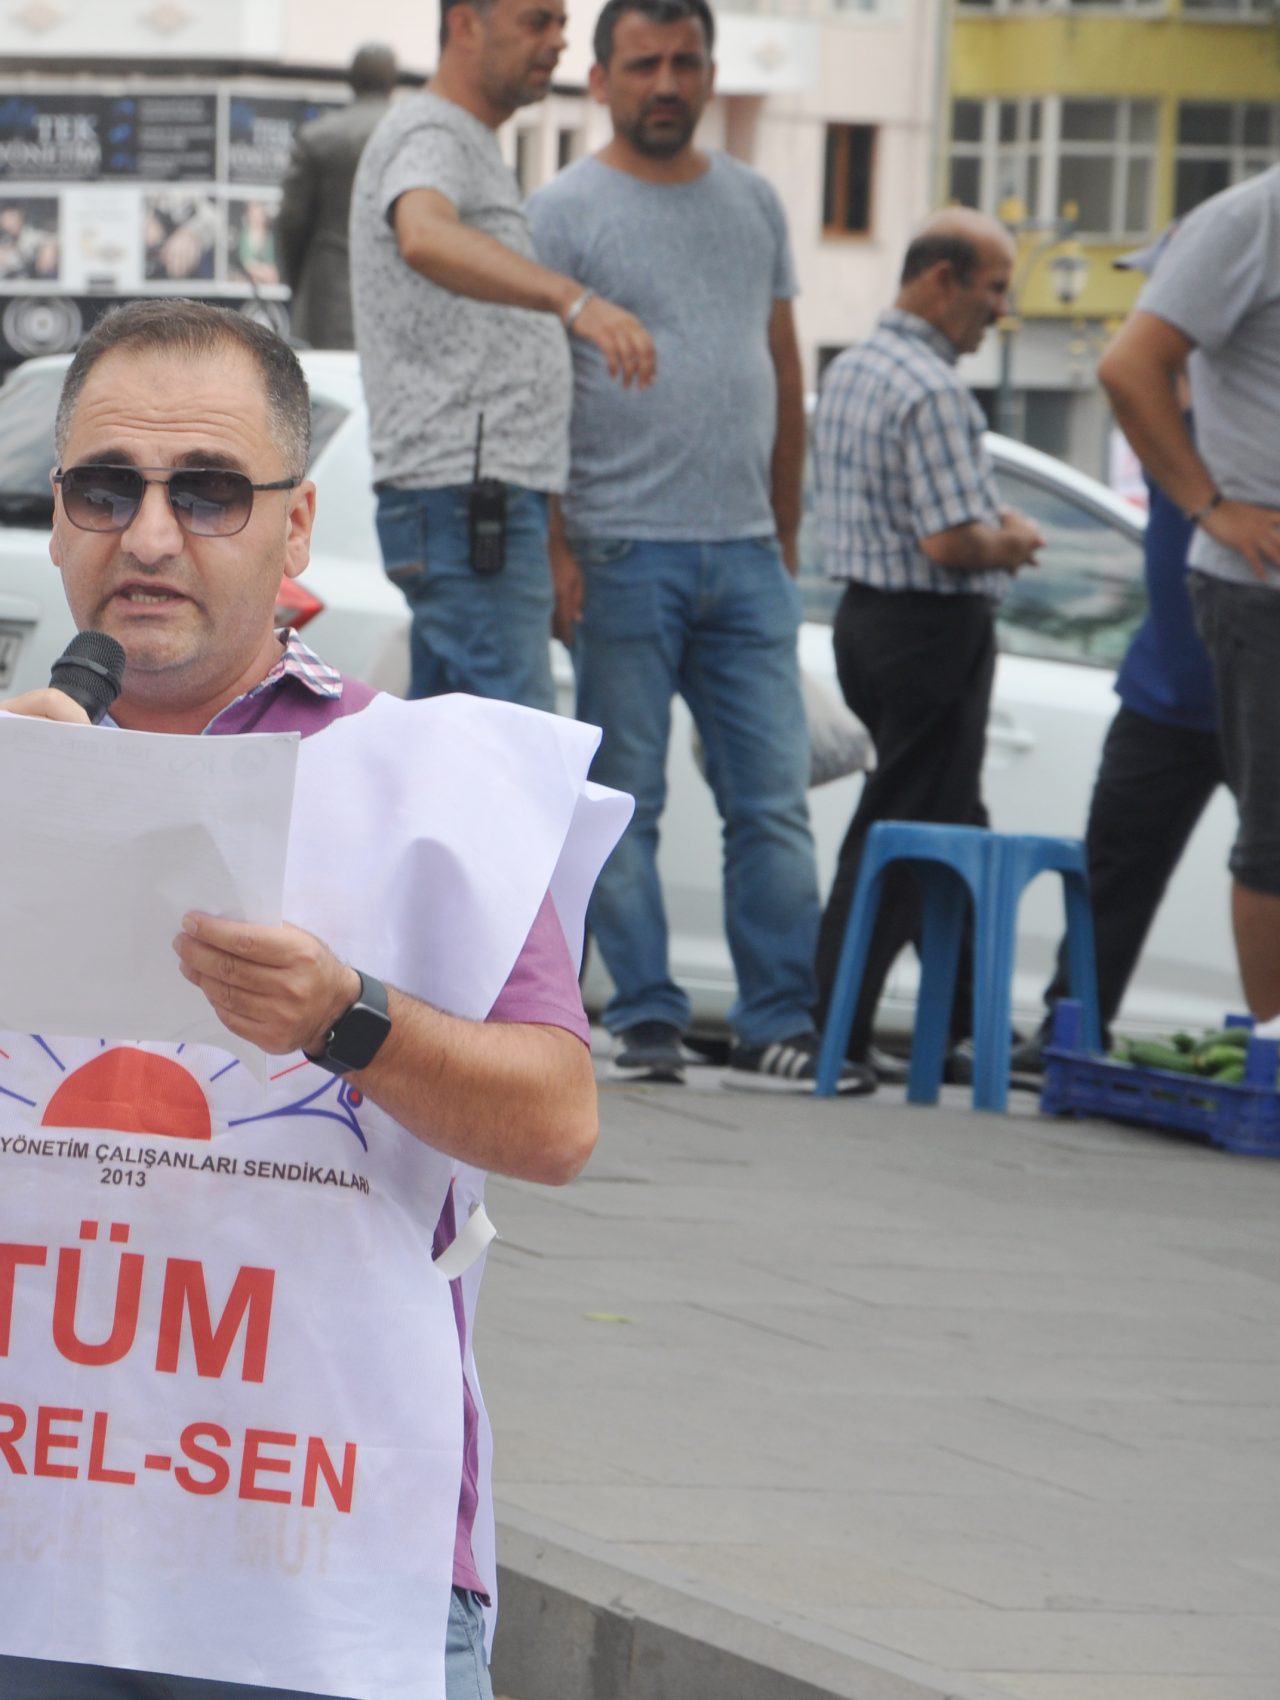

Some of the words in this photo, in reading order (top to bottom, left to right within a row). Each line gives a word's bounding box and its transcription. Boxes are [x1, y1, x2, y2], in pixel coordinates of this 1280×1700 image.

[0, 1134, 90, 1159] YÖNETİM
[94, 1142, 238, 1175] ÇALIŞANLARI
[243, 1158, 370, 1195] SENDİKALARI
[100, 1167, 146, 1188] 2013
